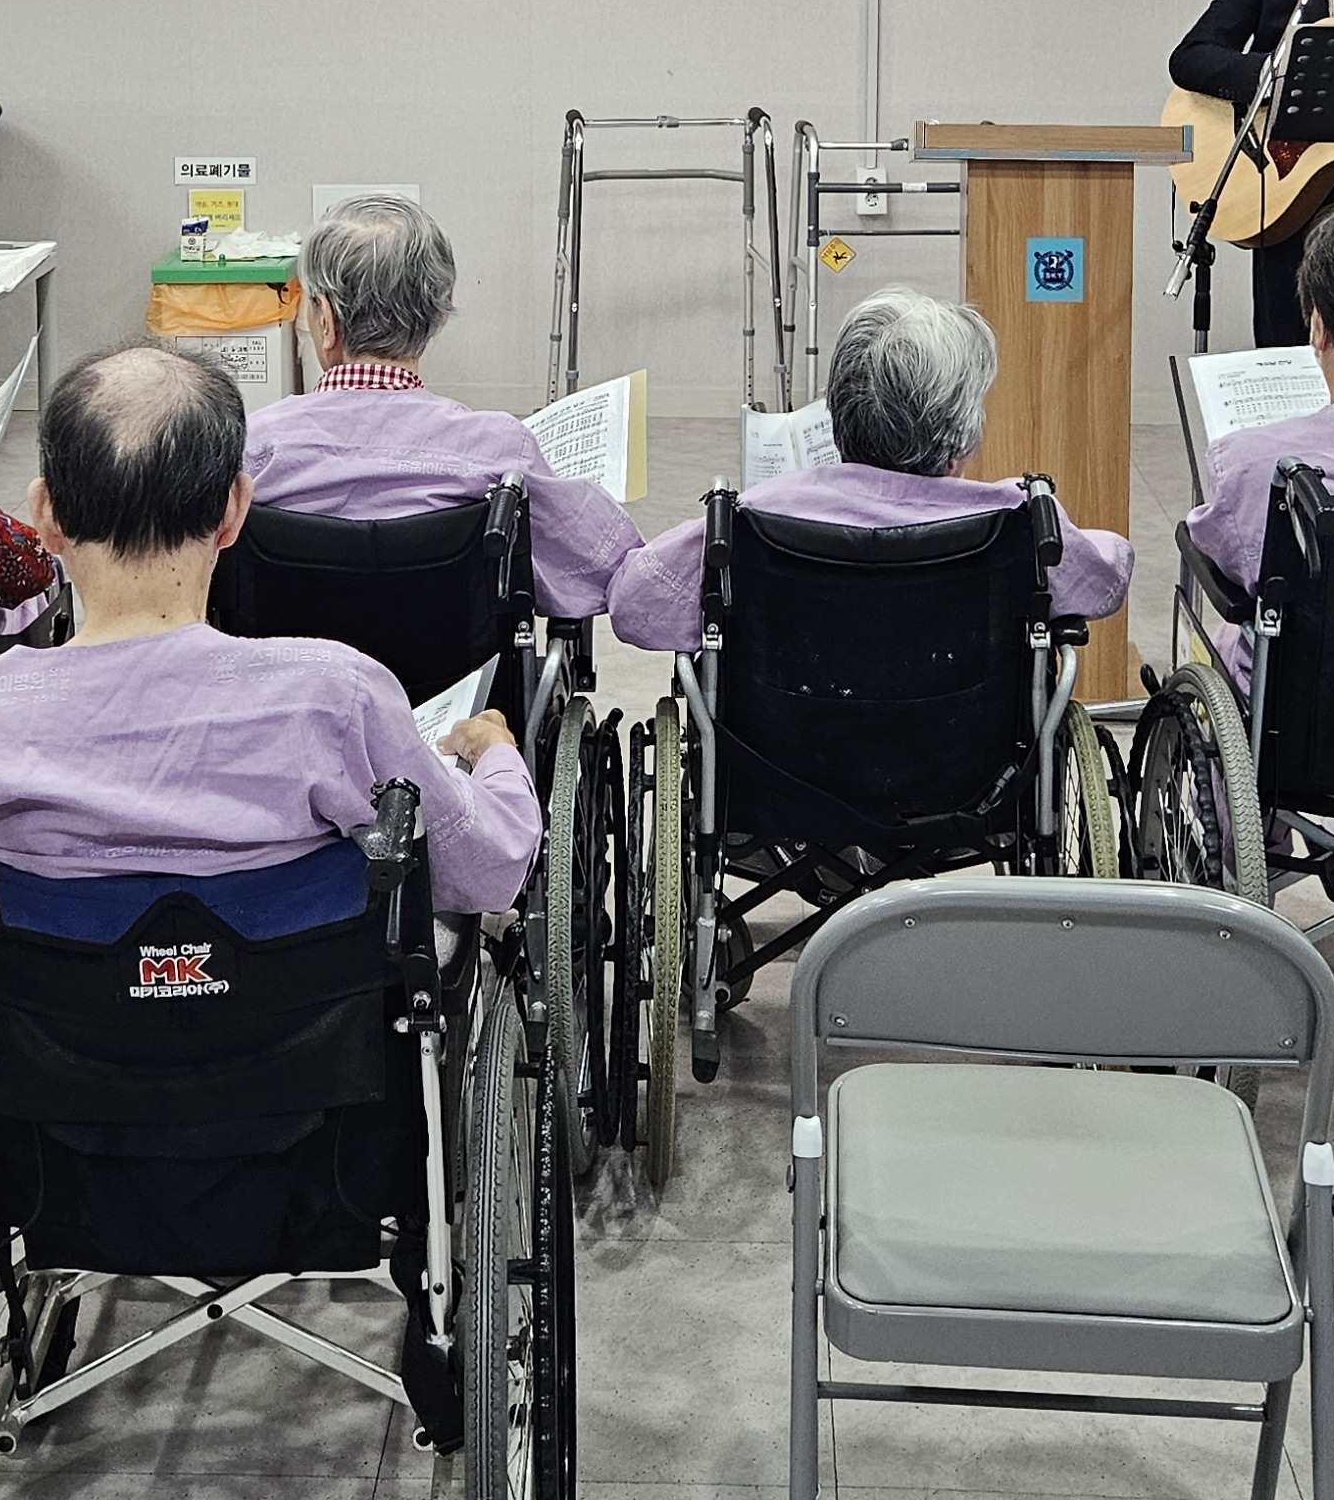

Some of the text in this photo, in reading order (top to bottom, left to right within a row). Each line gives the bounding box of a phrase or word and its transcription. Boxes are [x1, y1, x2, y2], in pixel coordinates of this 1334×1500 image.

[180, 163, 251, 178] 의료폐기물
[247, 647, 333, 668] 스카이병원
[139, 942, 212, 957] Wheel Chair
[139, 953, 213, 986] MK
[129, 980, 229, 998] 미키코리아(주)
